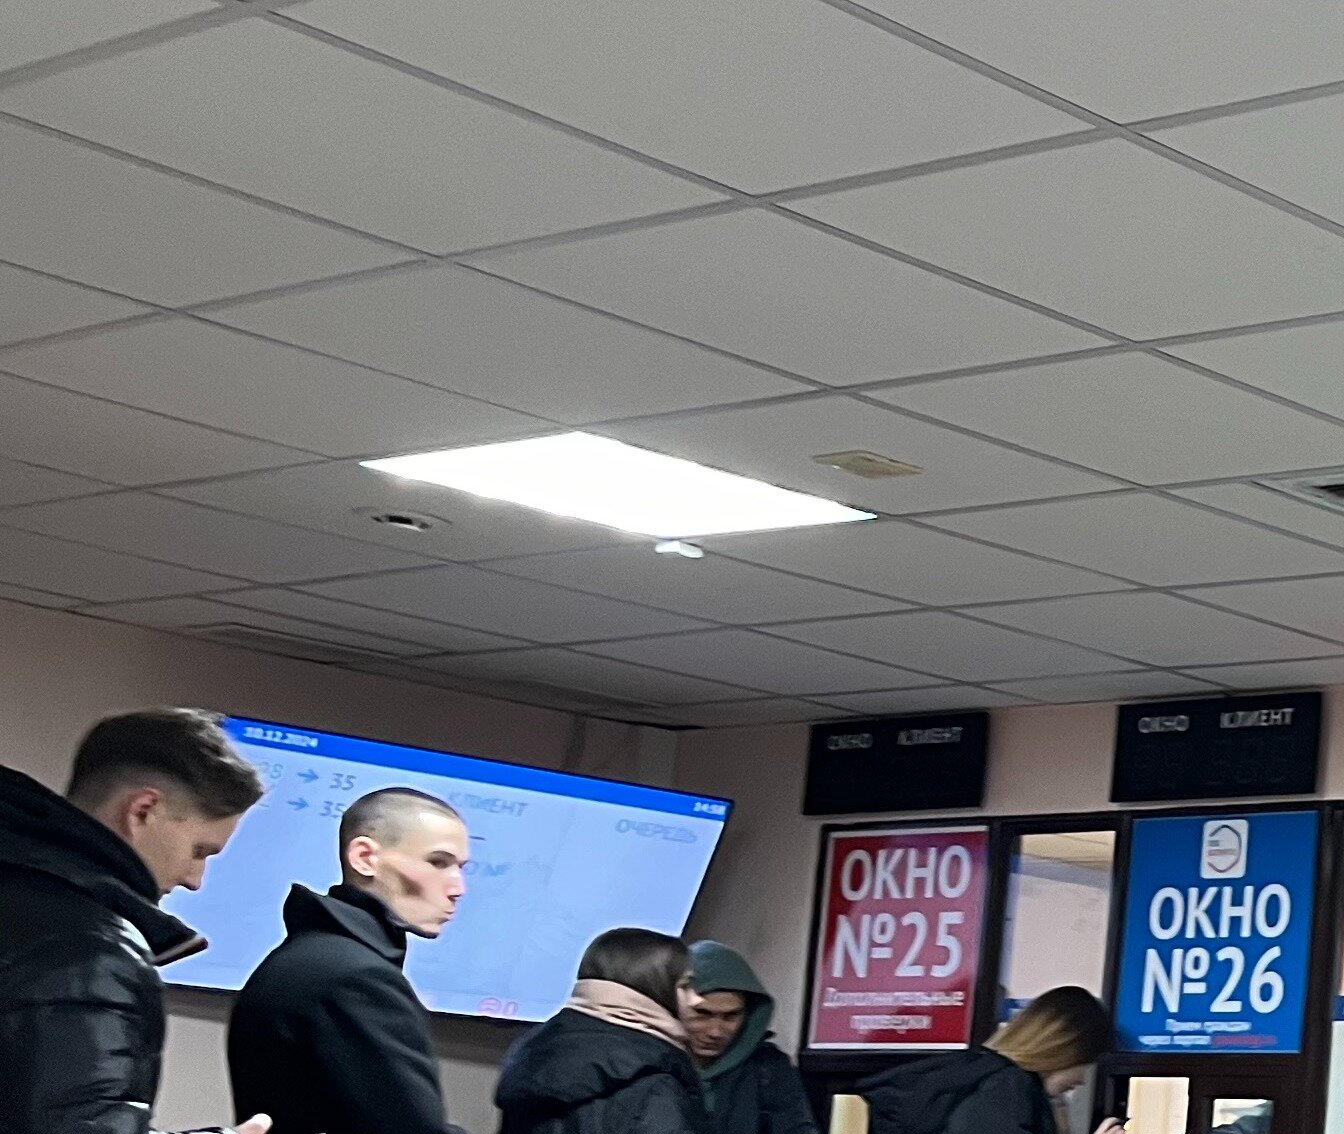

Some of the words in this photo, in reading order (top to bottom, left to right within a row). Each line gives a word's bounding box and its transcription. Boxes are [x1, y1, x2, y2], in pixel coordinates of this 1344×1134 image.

[840, 844, 973, 901] ОКНО
[1148, 883, 1292, 940] ОКНО
[831, 910, 965, 978] №25
[1140, 945, 1286, 1014] №26
